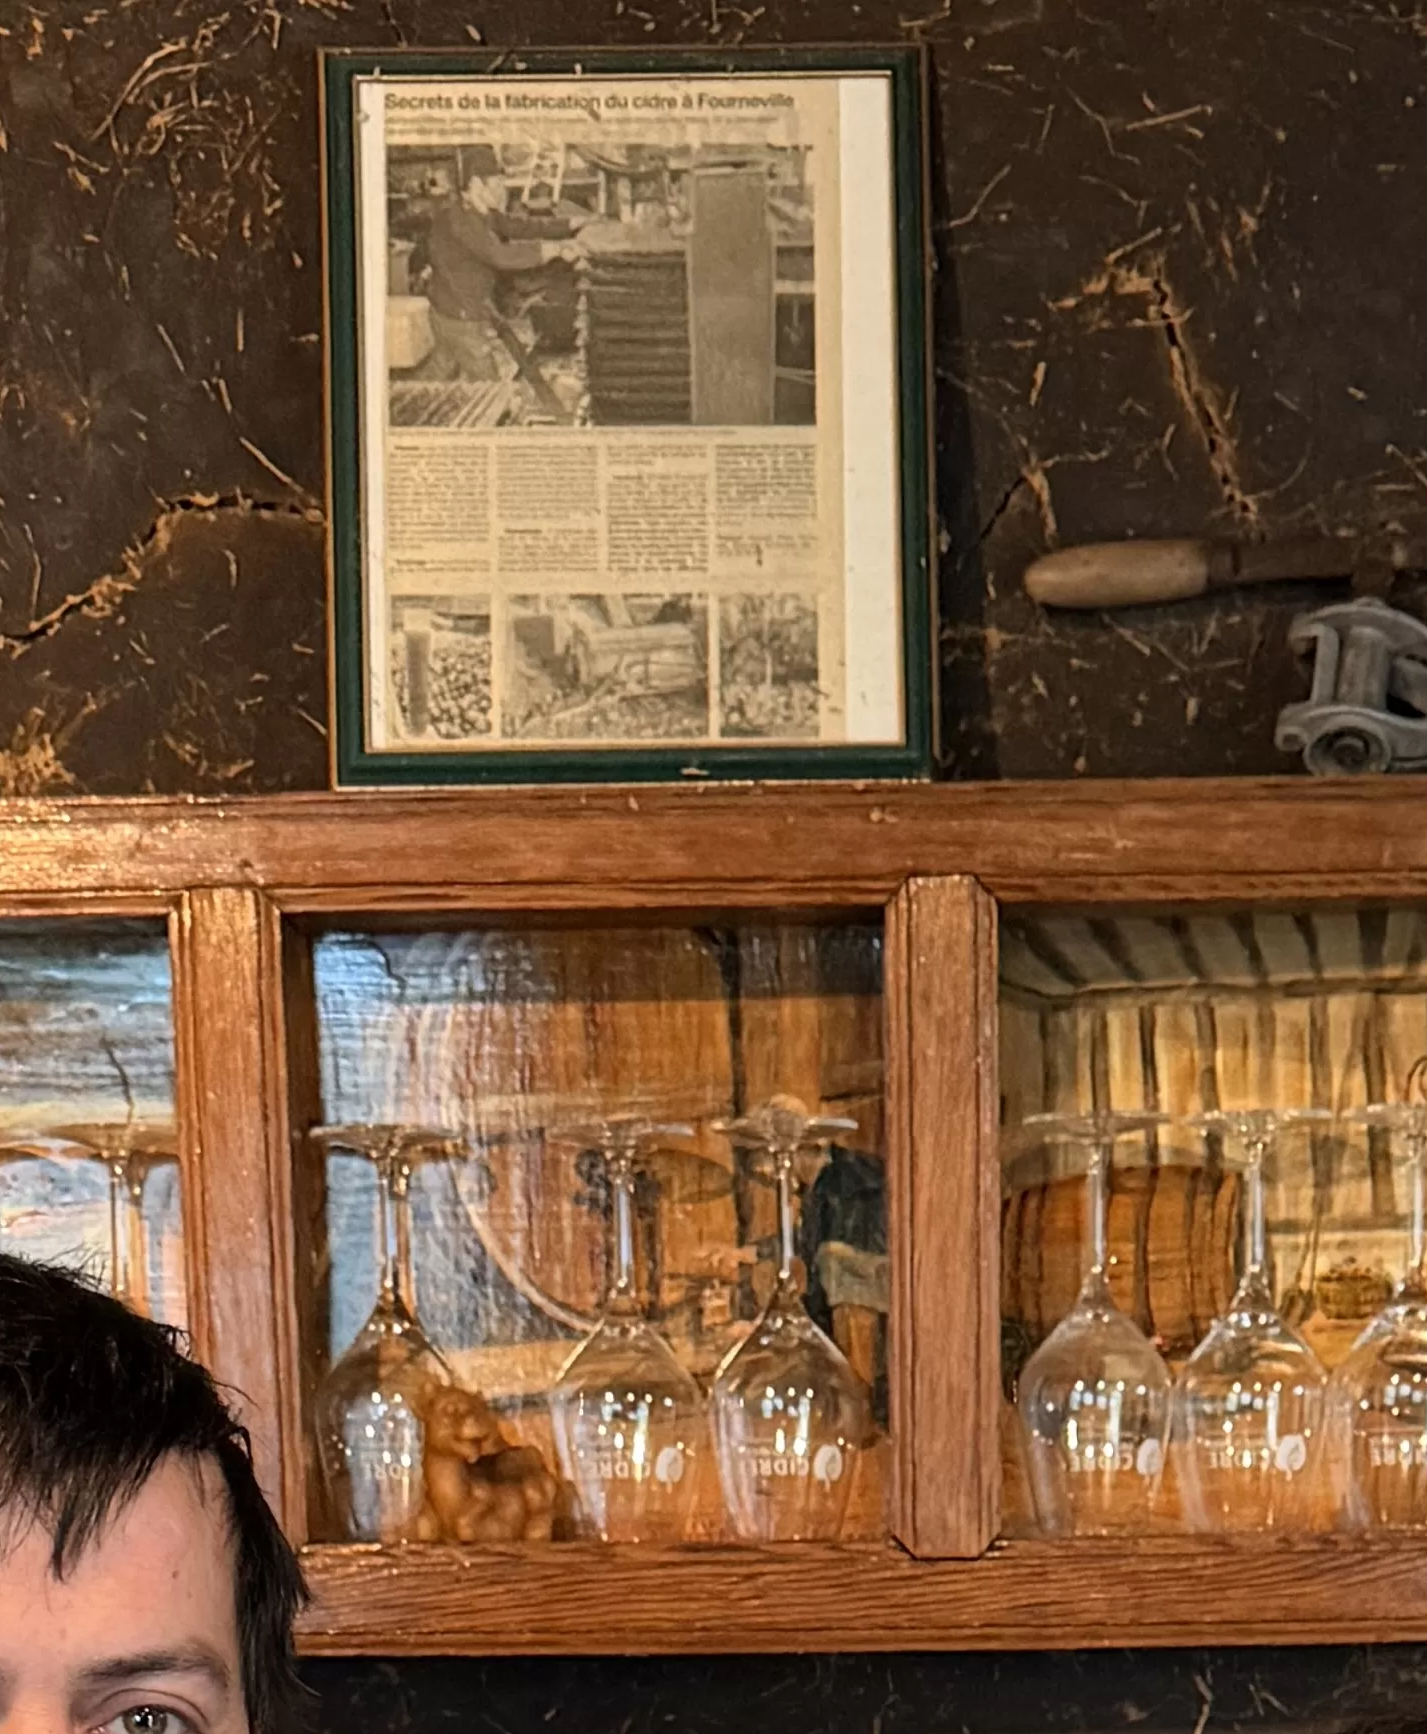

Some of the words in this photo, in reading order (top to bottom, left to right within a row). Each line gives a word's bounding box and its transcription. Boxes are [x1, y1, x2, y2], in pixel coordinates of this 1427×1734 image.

[384, 93, 453, 110] Secrets
[457, 93, 481, 110] de
[484, 93, 501, 110] la
[505, 93, 601, 110] fabrication
[604, 93, 628, 109] du
[633, 93, 678, 109] cidre
[697, 92, 795, 109] Fourneville
